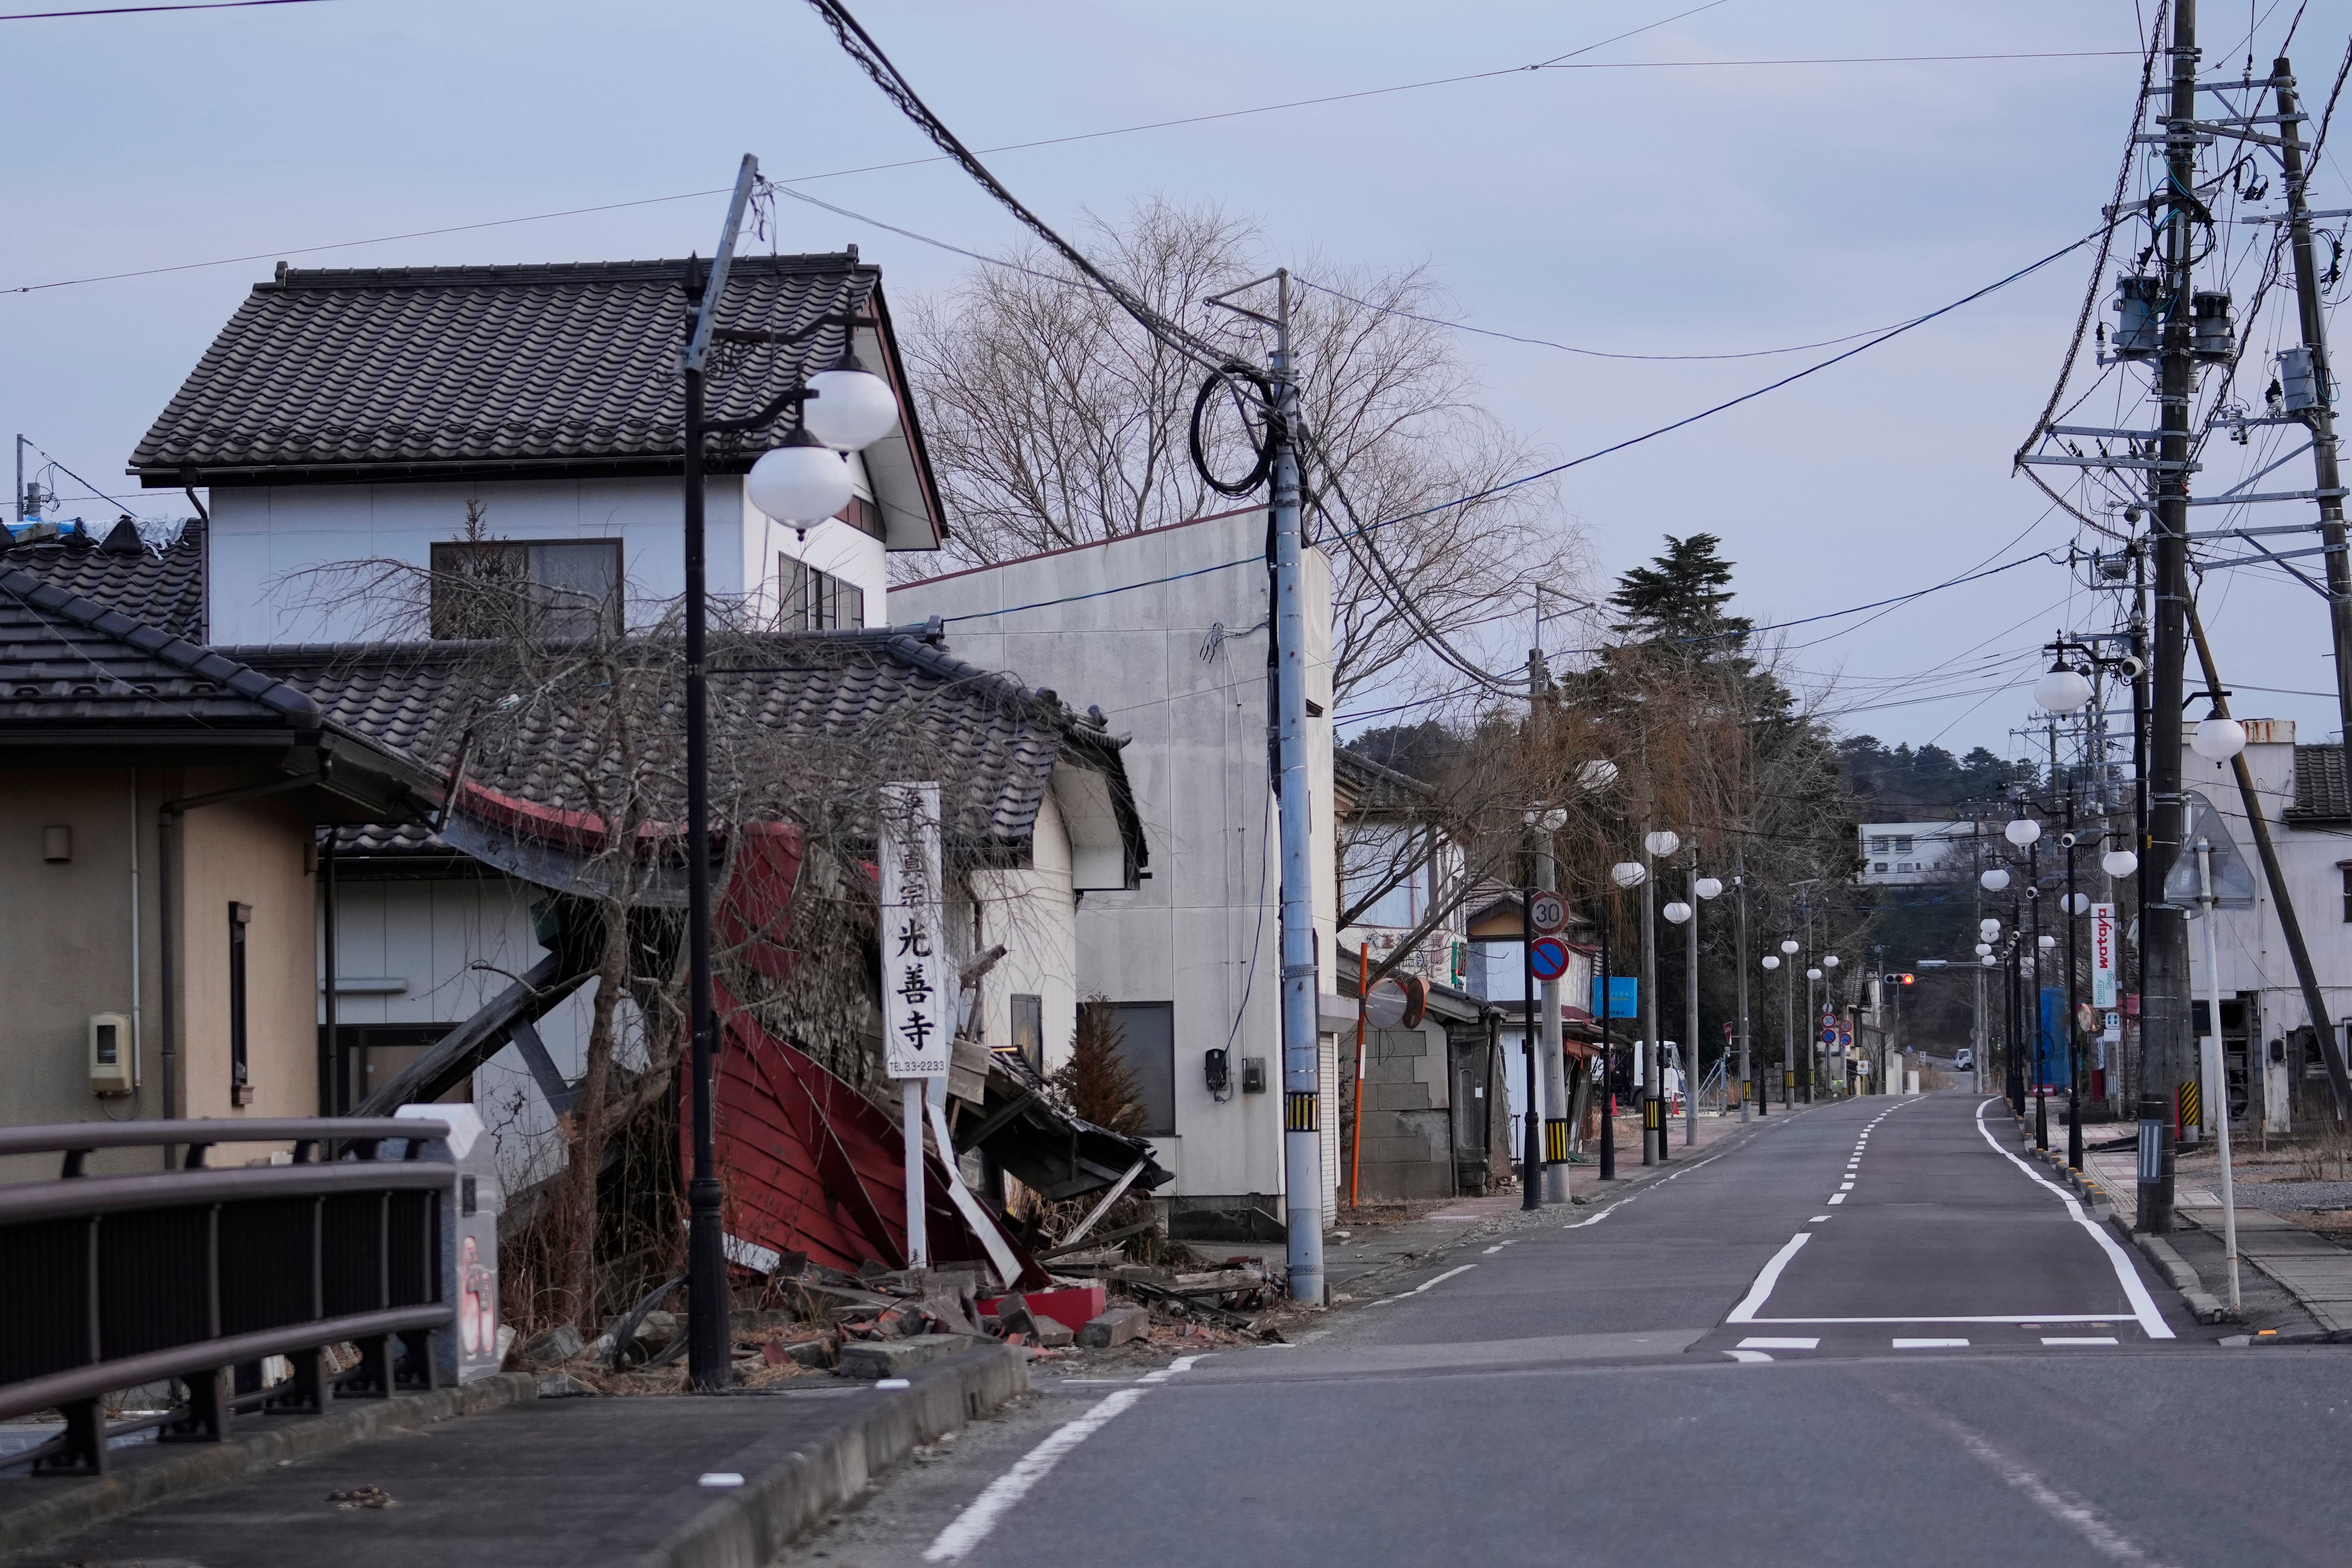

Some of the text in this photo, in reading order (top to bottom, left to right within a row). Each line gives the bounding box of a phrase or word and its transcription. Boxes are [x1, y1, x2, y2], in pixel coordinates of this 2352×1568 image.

[1536, 903, 1559, 923] 30
[2097, 908, 2112, 968] wataya
[889, 1060, 945, 1071] TEL.33-2233
